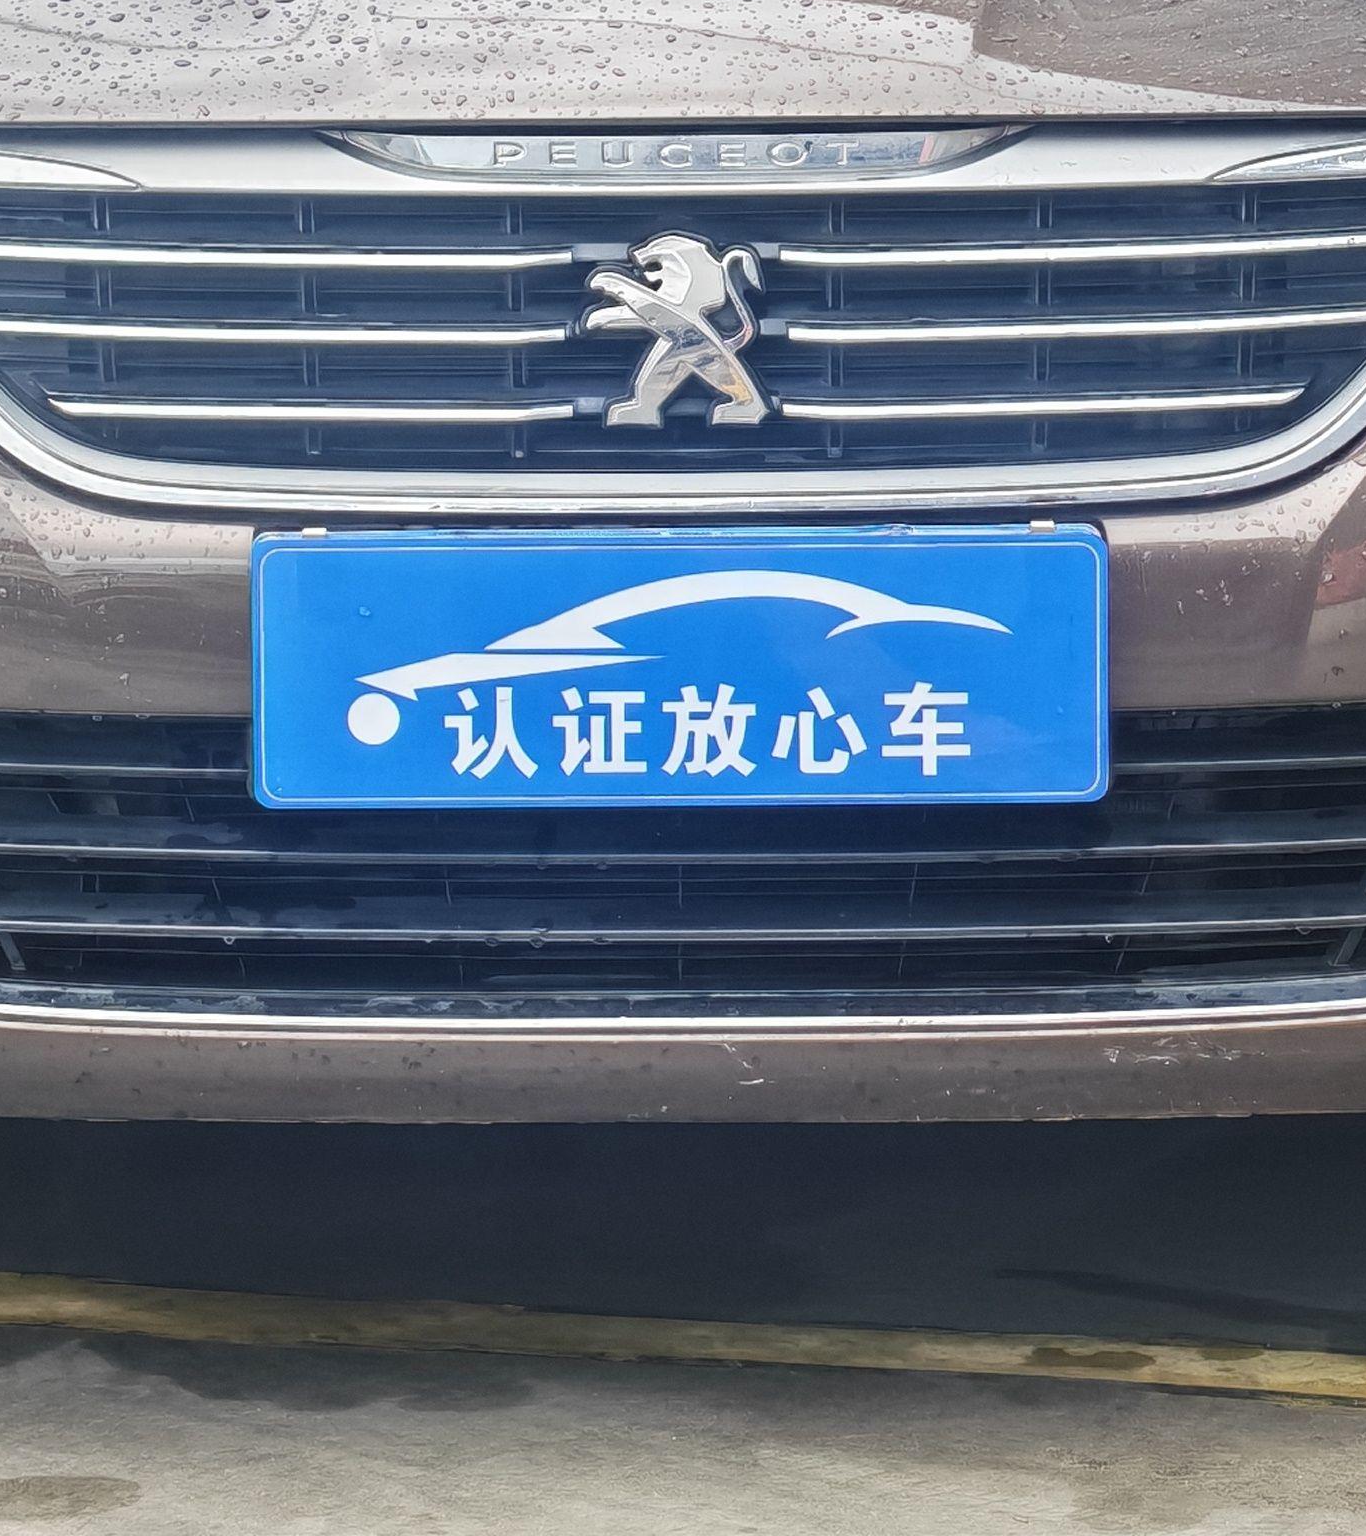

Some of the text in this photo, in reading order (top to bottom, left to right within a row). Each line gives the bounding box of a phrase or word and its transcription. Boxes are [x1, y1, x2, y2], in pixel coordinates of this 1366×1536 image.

[492, 139, 860, 168] PEUGEOT
[443, 681, 972, 779] 认证放心车
